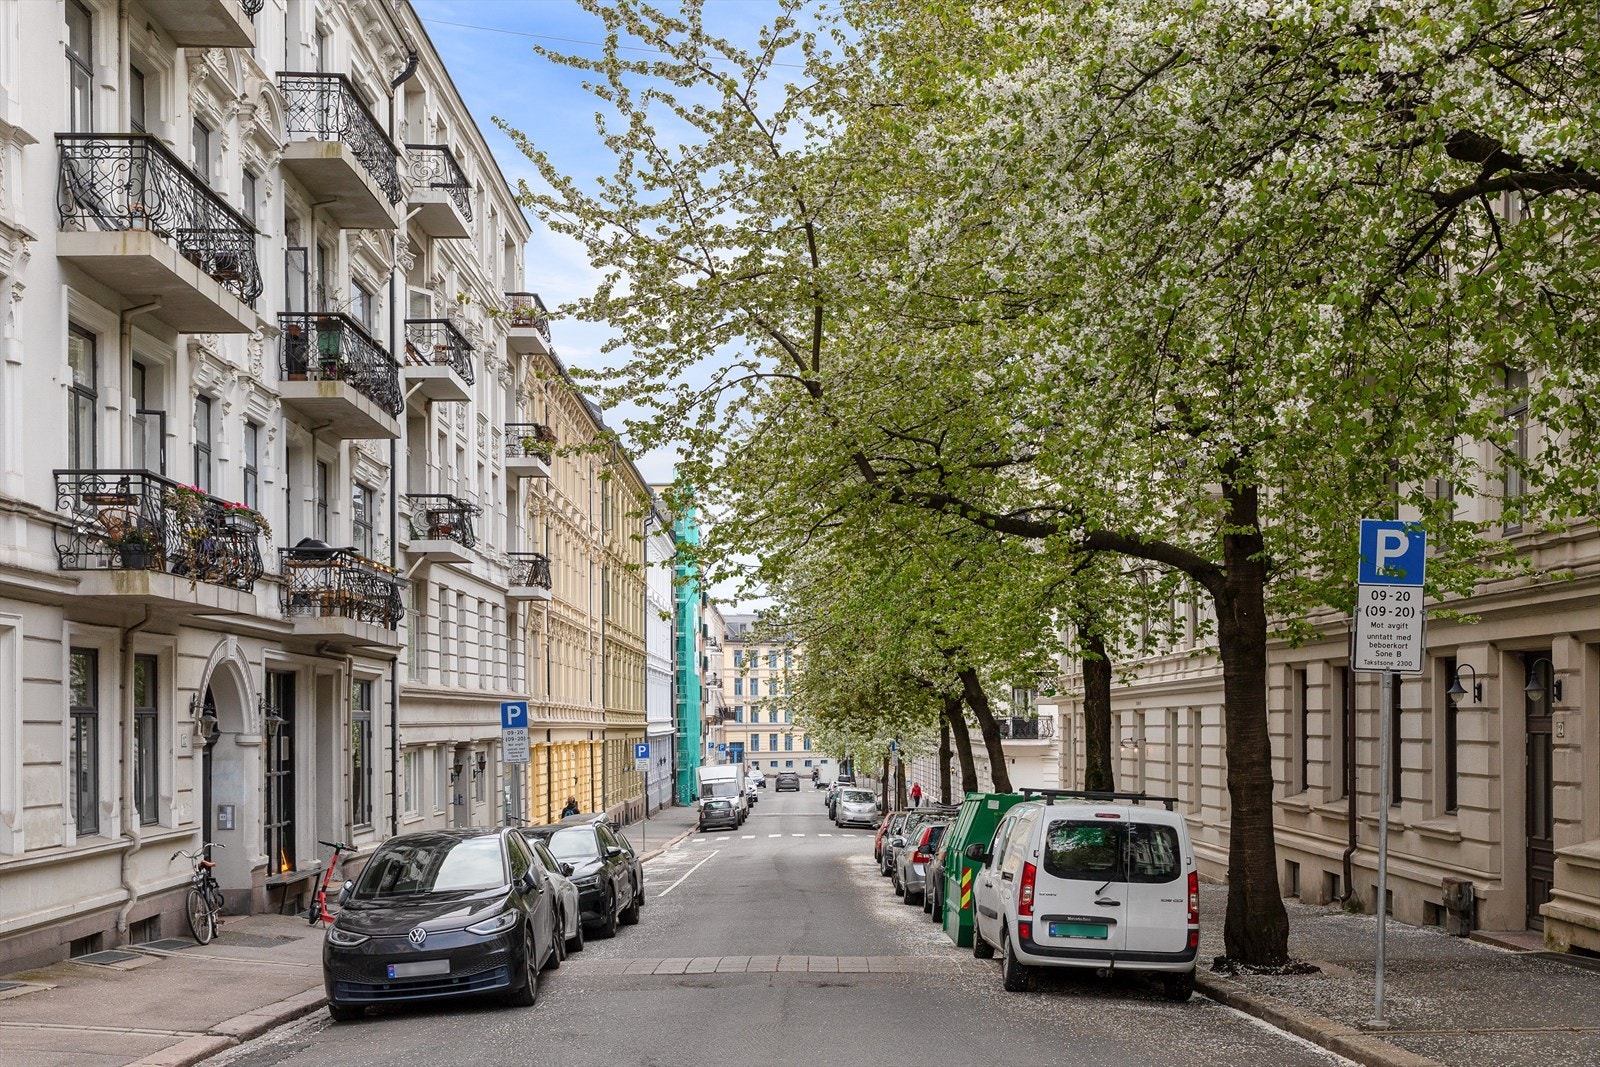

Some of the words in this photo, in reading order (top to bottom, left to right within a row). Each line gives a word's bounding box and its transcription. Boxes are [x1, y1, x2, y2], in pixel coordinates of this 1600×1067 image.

[1375, 529, 1410, 576] P
[1371, 590, 1411, 602] 09-20
[1365, 605, 1415, 619] (09-20)
[1370, 621, 1384, 629] Mot
[1387, 622, 1409, 631] avgift
[1369, 641, 1408, 650] beboerkort
[1364, 659, 1394, 667] Takstsone
[507, 705, 521, 725] P
[638, 745, 646, 757] P
